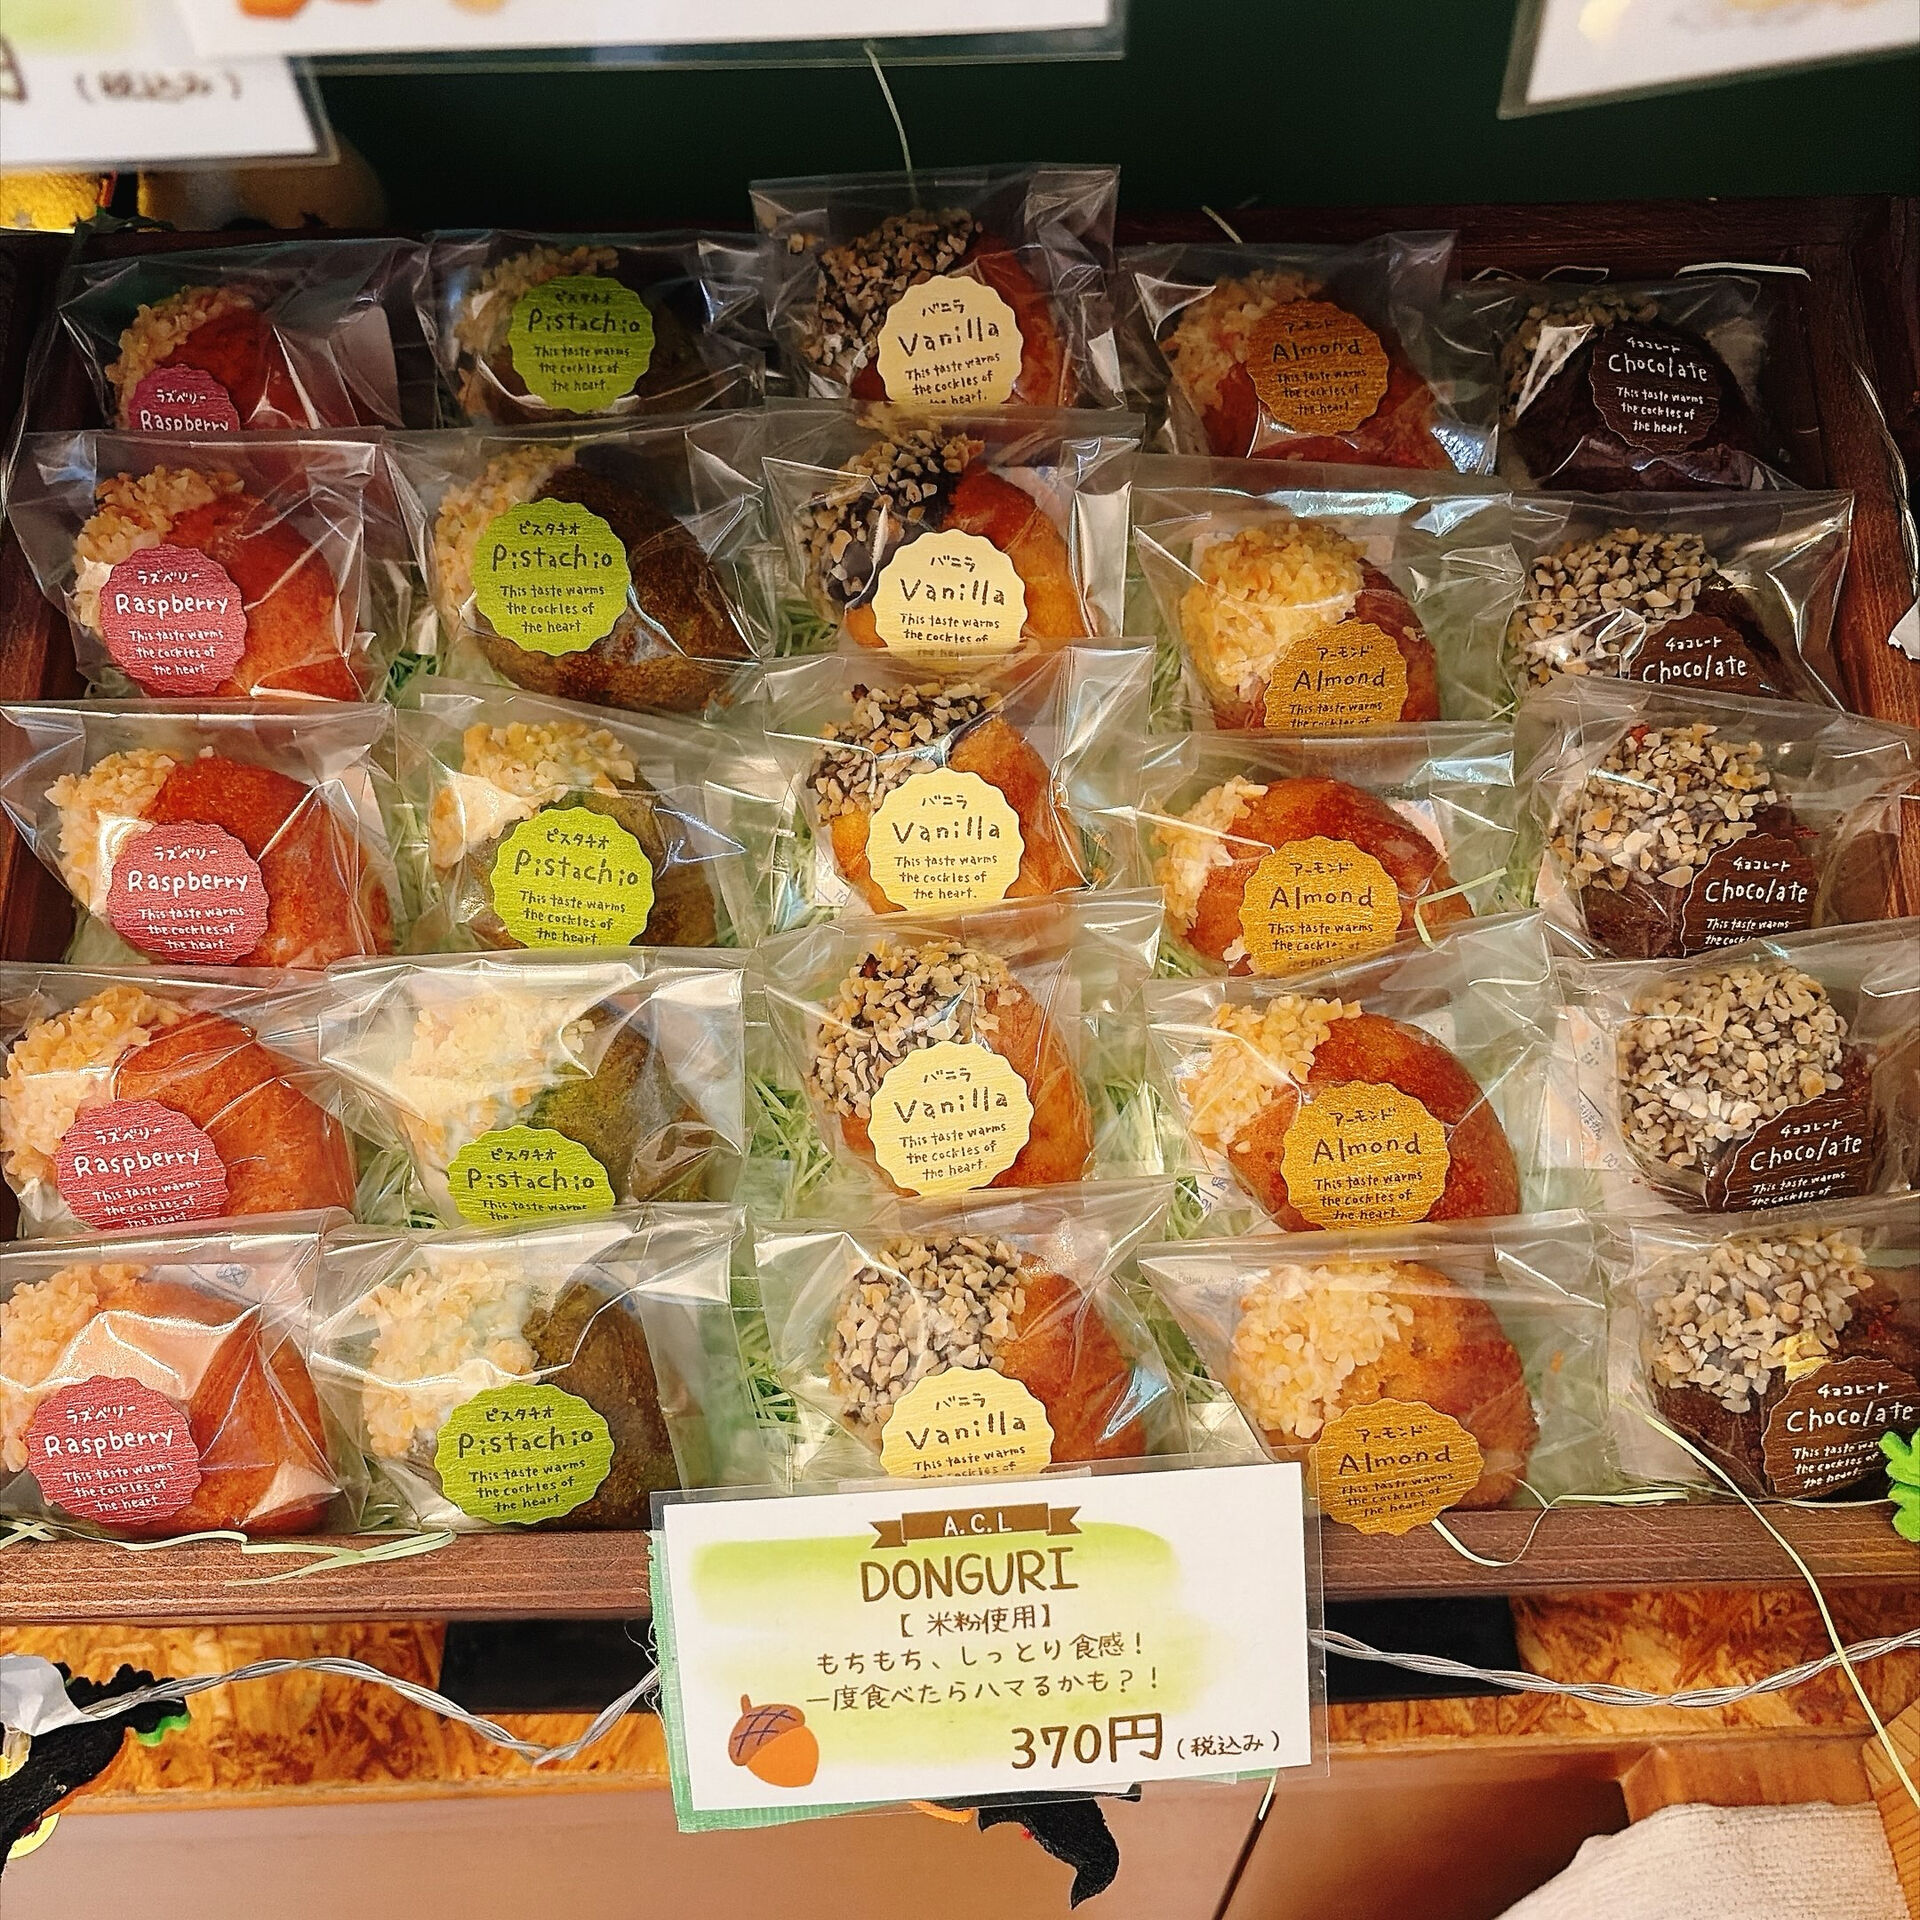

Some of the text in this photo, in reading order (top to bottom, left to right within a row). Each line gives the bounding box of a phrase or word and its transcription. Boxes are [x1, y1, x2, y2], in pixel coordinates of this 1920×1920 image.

[922, 299, 965, 317] バニラ
[528, 307, 640, 334] Pistachio
[898, 317, 1000, 357] Vanilla
[1627, 337, 1680, 353] チョコレート
[1273, 339, 1362, 363] Almond
[905, 353, 1000, 381] This taste warms
[1608, 353, 1707, 381] Chocolate
[912, 370, 993, 395] the cockles of
[156, 389, 207, 404] ラズベリー
[1616, 387, 1704, 404] This taste warms
[1621, 402, 1695, 420] the cockles of
[1633, 420, 1687, 434] the heart.
[519, 520, 580, 535] ピスタチオ
[492, 543, 613, 571] Pistachio
[930, 555, 976, 572] バニラ
[137, 569, 200, 585] ラズベリー
[500, 585, 605, 598] This taste warms
[900, 579, 1005, 606] Vanilla
[115, 593, 228, 620] Raspberry
[506, 602, 594, 615] the cockles of
[521, 621, 542, 633] the
[900, 613, 1000, 629] This taste warms
[128, 629, 224, 643] This taste warms
[1665, 636, 1722, 652] チョコレート
[136, 646, 215, 659] the cockles of
[1317, 645, 1373, 661] アーモンド
[1293, 667, 1385, 692] Almond
[1643, 655, 1747, 684] Chocolate
[922, 795, 967, 809] バニラ
[547, 828, 609, 849] ピスタチオ
[892, 816, 1000, 844] Vanilla
[154, 845, 219, 861] ラズベリー
[894, 855, 998, 868] This taste warms
[514, 849, 639, 886] Pistachio
[1289, 862, 1353, 876] アーモンド
[1733, 856, 1791, 872] チョコレート
[128, 870, 248, 898] Raspberry
[899, 871, 987, 883] the cockles of
[520, 890, 626, 913] This taste warms
[914, 888, 977, 899] the heart.
[1269, 886, 1374, 910] Almond
[1705, 879, 1808, 903] Chocolate
[138, 907, 245, 920] This taste warms
[523, 908, 614, 930] the cockles of
[148, 923, 236, 935] the cockles of
[1268, 923, 1373, 935] This taste warms
[923, 1067, 972, 1084] バニラ
[893, 1086, 1008, 1123] Vanilla
[1329, 1107, 1396, 1127] アーモンド
[95, 1127, 163, 1145] ラズベリー
[899, 1122, 1006, 1149] This taste warms
[1780, 1118, 1843, 1138] チョコレート
[490, 1147, 557, 1161] ピスタチオ
[906, 1140, 997, 1165] the cockles of
[1313, 1132, 1422, 1164] Almond
[1750, 1134, 1862, 1171] Chocolate
[73, 1148, 200, 1178] Raspberry
[922, 1158, 988, 1181] the heart.
[467, 1167, 595, 1191] Pistachio
[1313, 1171, 1423, 1191] This taste warms
[1320, 1189, 1412, 1207] the cockles of
[1817, 1381, 1890, 1399] チョコレート
[936, 1392, 986, 1411] バニラ
[66, 1404, 136, 1425] ラズベリー
[485, 1405, 554, 1422] ピスタチオ
[1786, 1401, 1914, 1433] Chocolate
[906, 1410, 1026, 1450] Vanilla
[1354, 1424, 1429, 1443] アーモンド
[43, 1428, 173, 1460] Raspberry
[458, 1425, 594, 1458] Pistachio
[1792, 1441, 1879, 1460] This taste war
[1338, 1445, 1453, 1475] Almond
[62, 1462, 174, 1484] This taste warms
[468, 1459, 586, 1484] This taste warms
[73, 1479, 167, 1498] the cockles of
[476, 1475, 575, 1499] the cockles of
[944, 1511, 1013, 1536] A.C.L
[861, 1547, 1079, 1602] DONGURI
[816, 1632, 1143, 1676] もちもち、しっとり食感！
[806, 1667, 1159, 1712] 一度食べたらハマるかも？！
[1011, 1712, 1280, 1770] 370円 (税込み)
